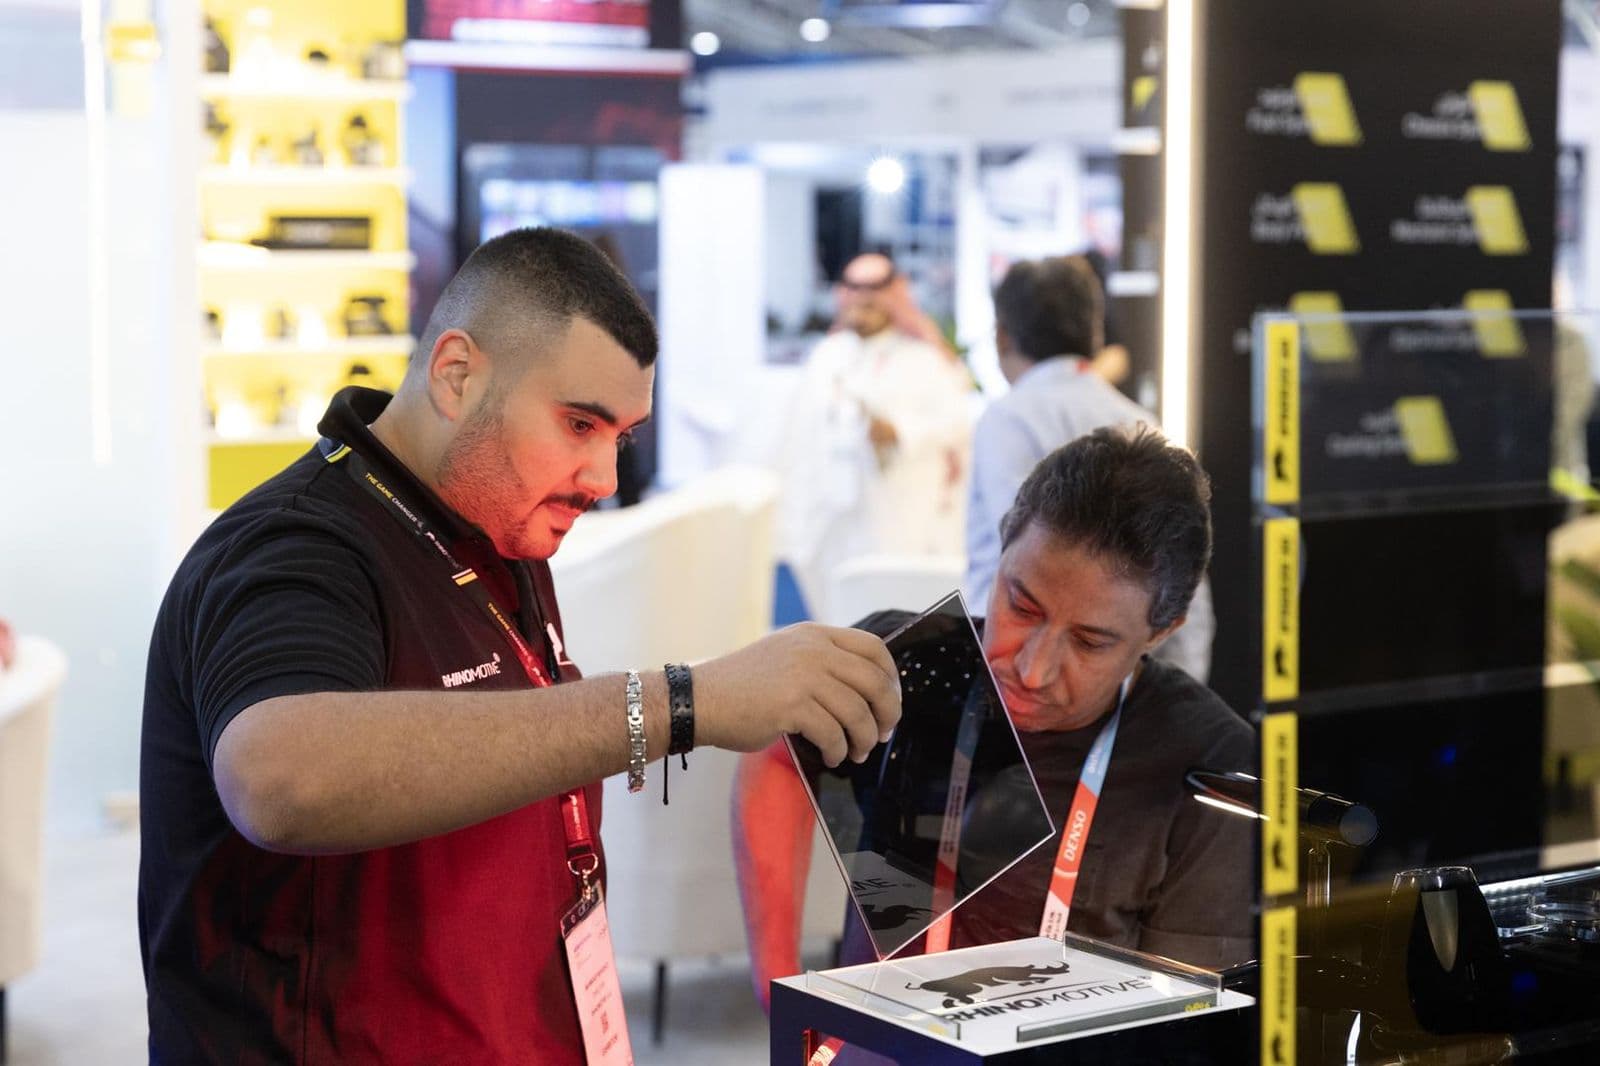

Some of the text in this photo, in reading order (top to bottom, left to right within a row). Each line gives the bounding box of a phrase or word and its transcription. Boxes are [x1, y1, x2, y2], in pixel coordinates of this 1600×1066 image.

[365, 472, 418, 522] THE GAME CHANGER
[442, 661, 501, 688] RHINOMOTIVE
[1063, 810, 1087, 862] DENSO
[943, 979, 1153, 1022] RHINOMOTIVE
